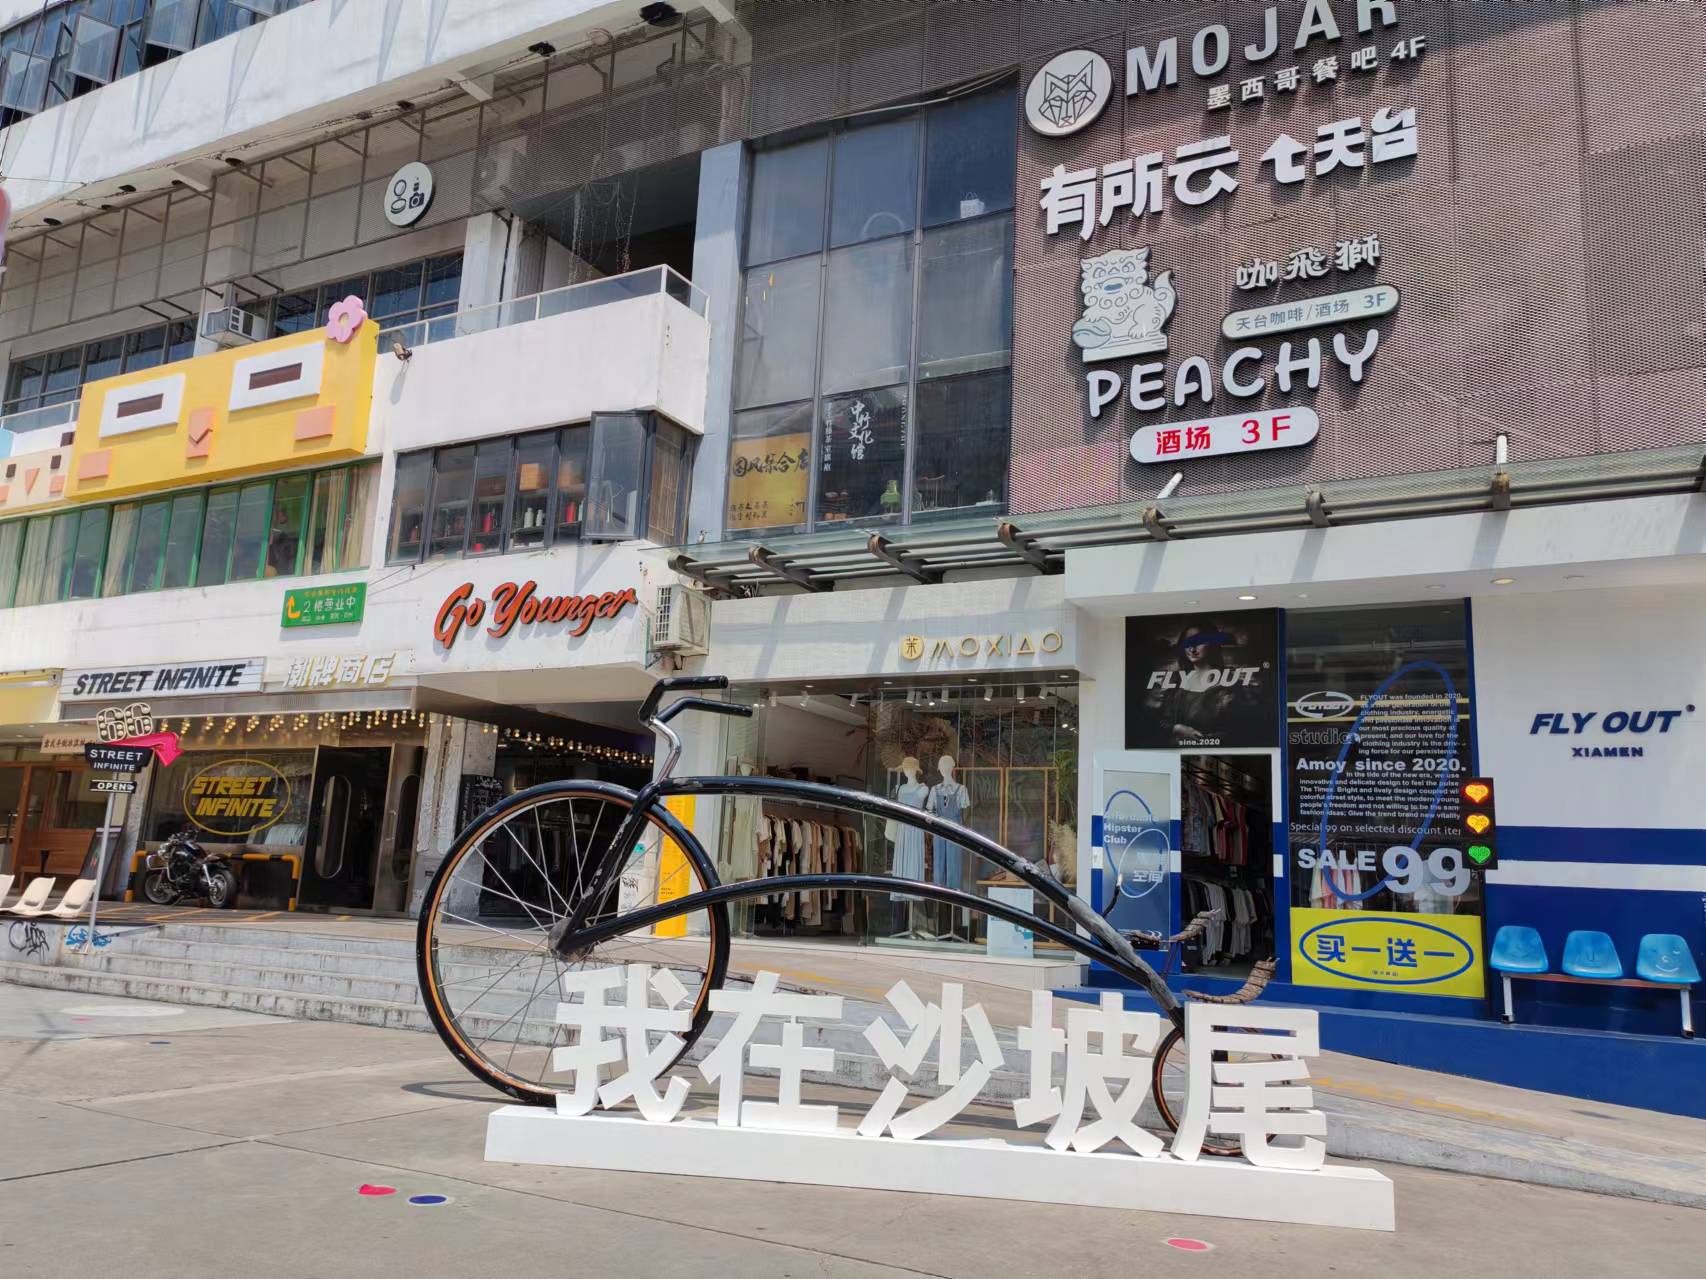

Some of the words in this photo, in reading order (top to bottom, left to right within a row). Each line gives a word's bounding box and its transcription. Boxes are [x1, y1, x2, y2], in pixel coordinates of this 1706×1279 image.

[1126, 0, 1397, 96] MOJAR
[1207, 45, 1377, 110] 墨西哥餐吧
[1391, 36, 1426, 60] 4F
[1236, 234, 1380, 289] 咖飛獅
[1236, 299, 1350, 331] 天台咖啡/酒场
[1363, 292, 1387, 309] 3F
[1086, 328, 1379, 418] PEACHY
[1155, 426, 1211, 456] 酒场
[1240, 415, 1292, 445] 3F
[434, 583, 486, 649] Go
[487, 580, 639, 638] Younger
[73, 671, 153, 695] STREET
[153, 663, 247, 691] INFINITE
[1146, 671, 1196, 690] FLY
[1200, 667, 1260, 689] OUT
[96, 702, 153, 742] 66
[1423, 725, 1447, 733] quality
[1529, 712, 1598, 735] FLY
[1601, 710, 1682, 734] OUT
[90, 749, 143, 760] STREET
[1571, 747, 1643, 757] XIAMEN
[93, 762, 135, 771] INFINITE
[1296, 757, 1347, 773] Amoy
[1355, 757, 1406, 771] since
[1412, 758, 1467, 772] 2020.
[97, 782, 126, 791] OPEN
[191, 776, 272, 795] STREET
[1337, 786, 1358, 794] Bright
[195, 798, 278, 817] INFINITE
[1104, 822, 1142, 834] Hipster
[1104, 834, 1127, 844] Club
[1290, 822, 1322, 833] Special
[1355, 823, 1395, 833] selected
[1398, 824, 1441, 835] discount
[1298, 849, 1376, 871] SALE
[1382, 846, 1471, 896] 99
[1316, 934, 1455, 968] 买一送一
[552, 963, 1328, 1171] 我在沙坡尾
